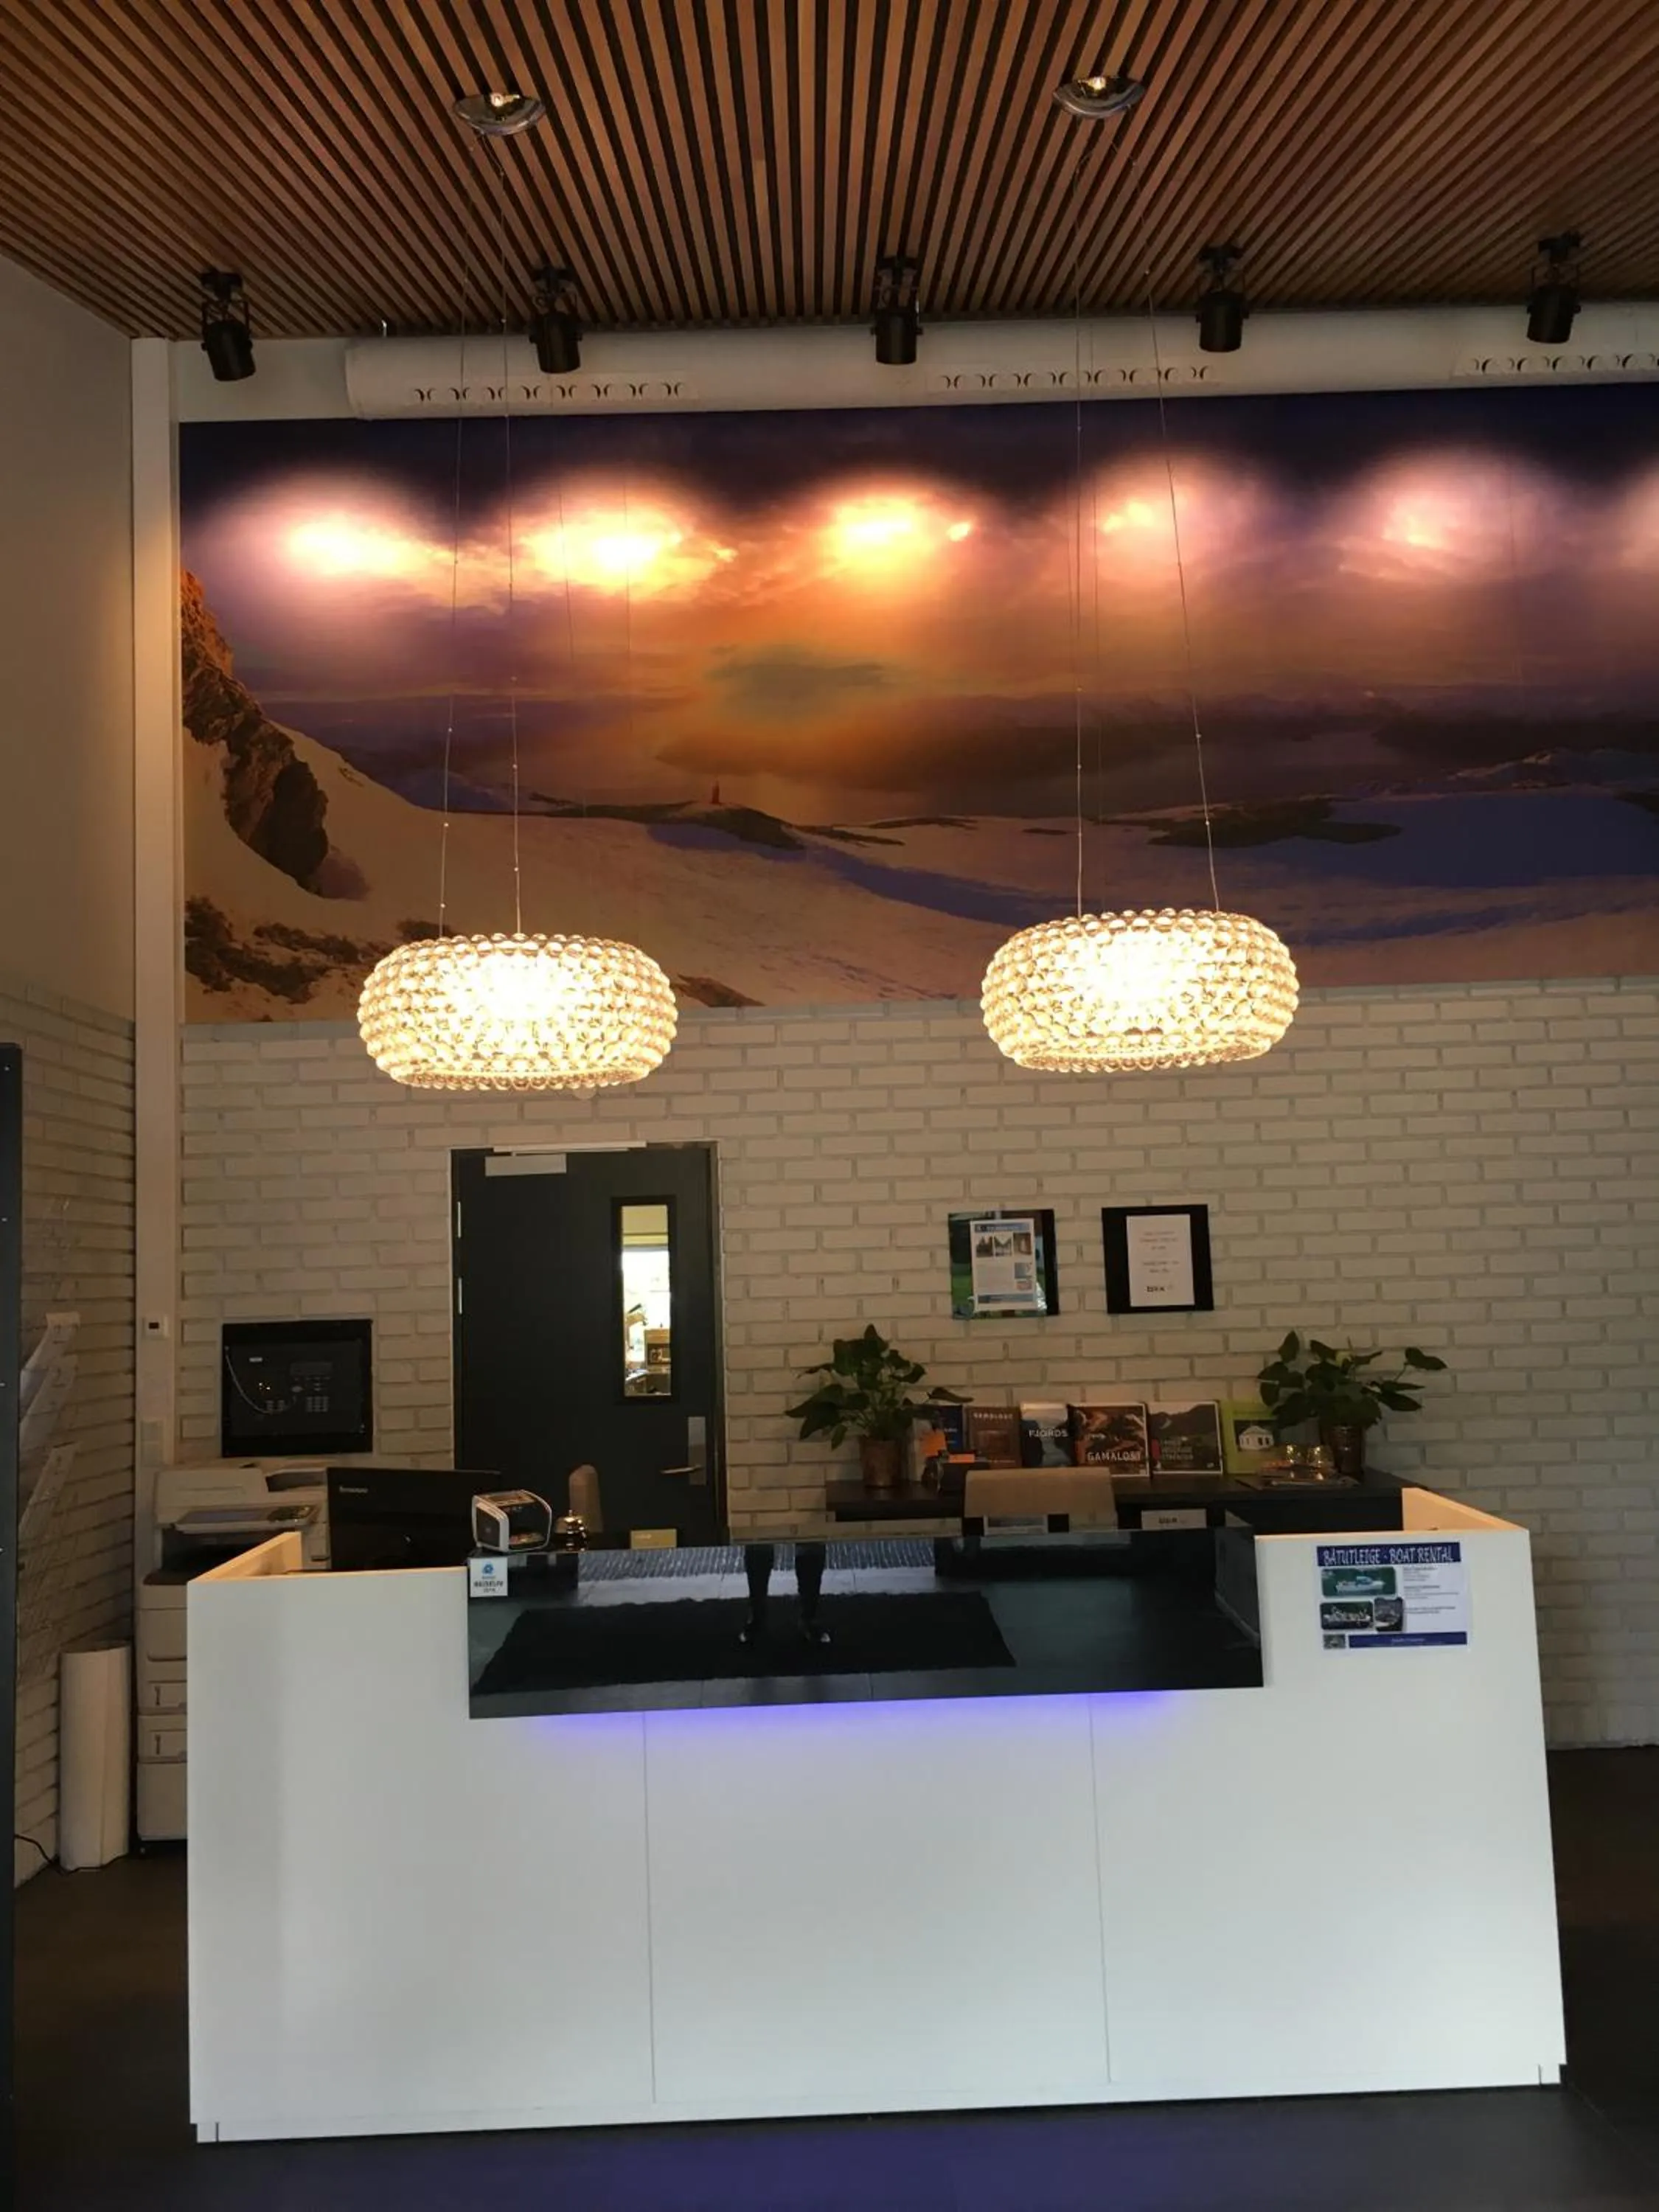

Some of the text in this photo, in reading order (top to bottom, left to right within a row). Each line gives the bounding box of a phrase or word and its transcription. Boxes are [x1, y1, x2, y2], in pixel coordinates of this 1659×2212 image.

[1088, 1450, 1141, 1461] GAMALOST
[1390, 1546, 1417, 1564] BOAT
[1417, 1545, 1453, 1563] RENTAL
